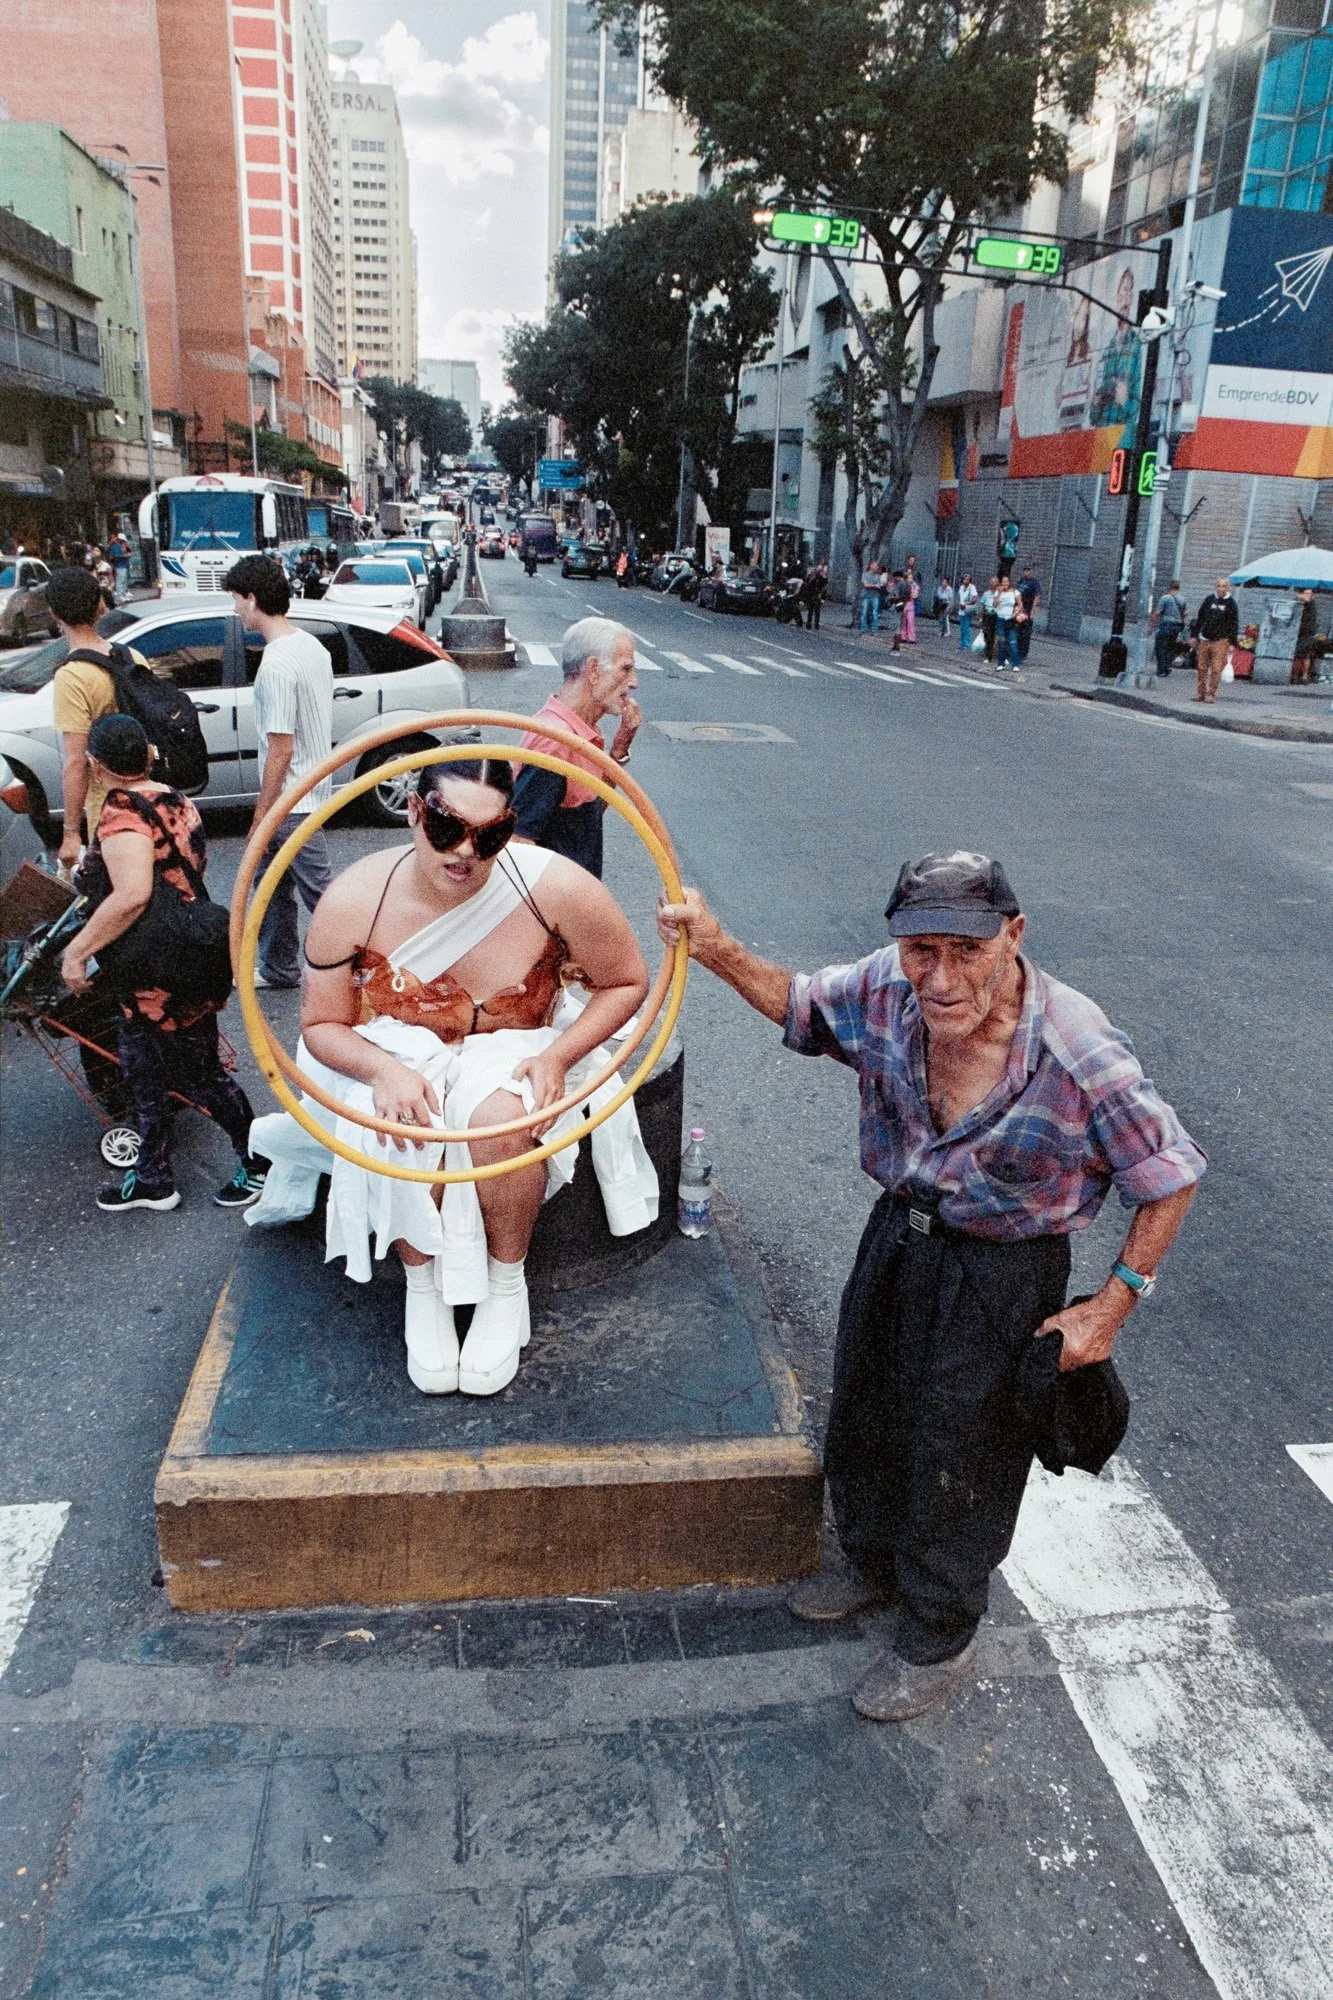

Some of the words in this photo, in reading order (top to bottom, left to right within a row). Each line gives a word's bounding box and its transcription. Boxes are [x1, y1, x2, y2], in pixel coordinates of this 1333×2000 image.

[829, 218, 860, 248] 39
[1030, 245, 1061, 274] 39
[1218, 384, 1319, 405] EmprendeBDV
